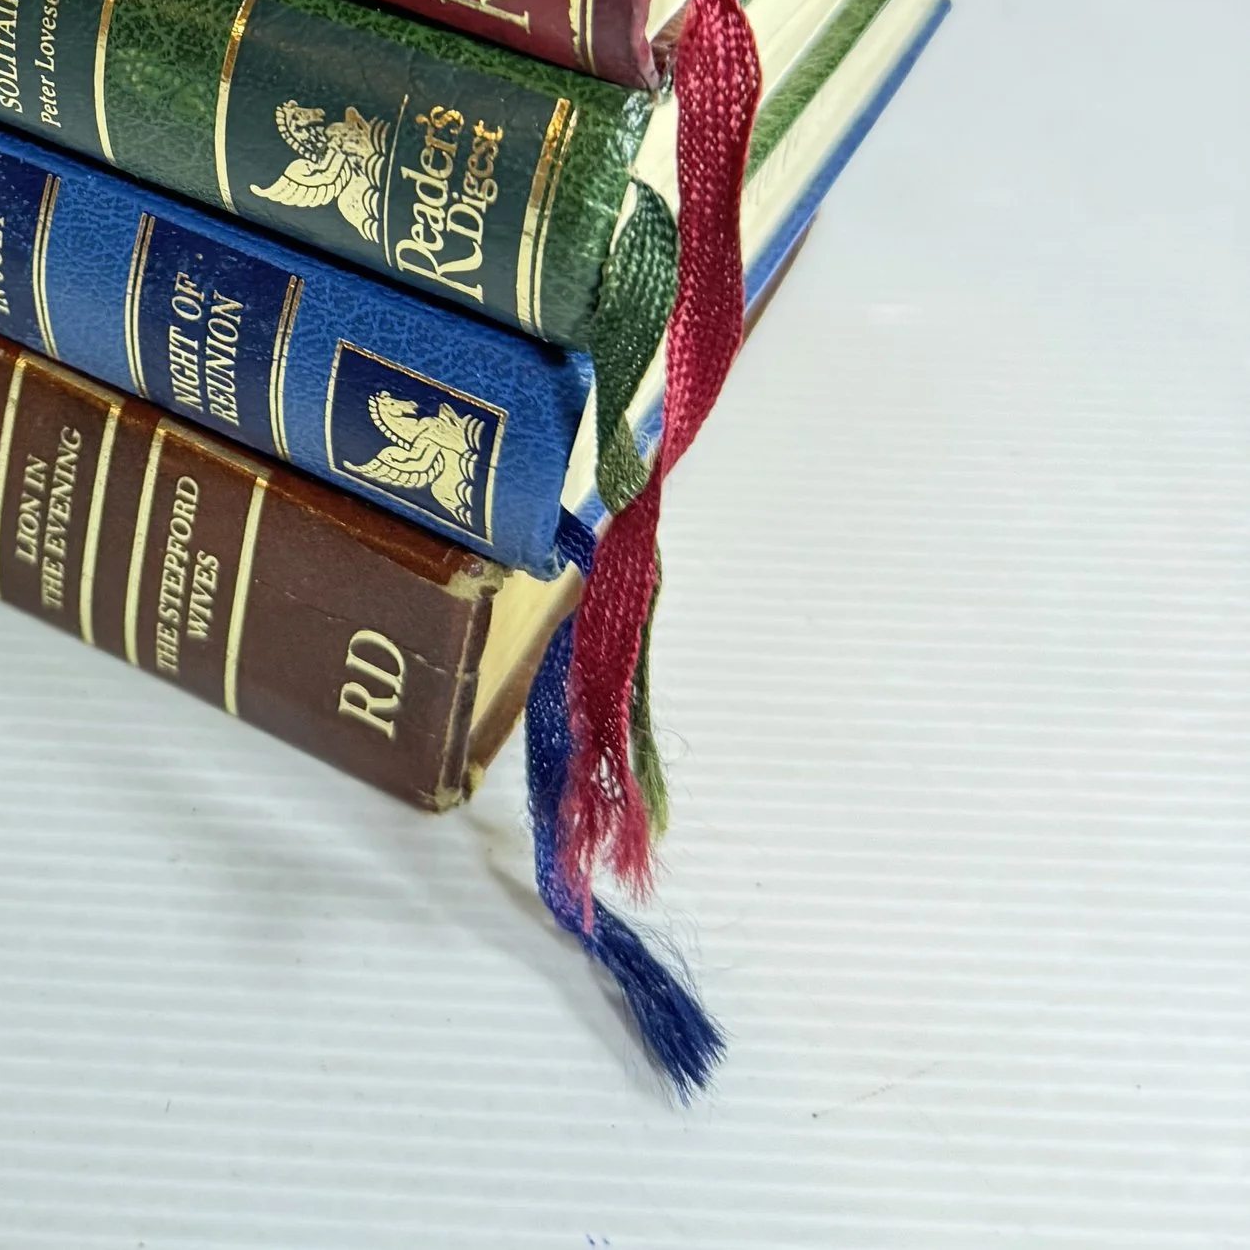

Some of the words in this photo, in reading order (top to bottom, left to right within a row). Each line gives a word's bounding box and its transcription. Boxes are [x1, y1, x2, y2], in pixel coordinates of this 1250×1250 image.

[39, 75, 62, 128] Peter
[395, 105, 484, 304] Reader's
[446, 119, 503, 245] Digest
[171, 271, 205, 321] OF
[169, 325, 204, 413] NIGHT
[205, 289, 244, 426] REUNION
[24, 453, 49, 493] IN
[43, 426, 82, 558] EVENING
[15, 493, 42, 565] LION
[158, 475, 199, 624] STEPFORD
[41, 556, 65, 610] THE
[187, 550, 220, 641] WIVES
[156, 623, 180, 678] THE
[338, 629, 406, 741] RD
